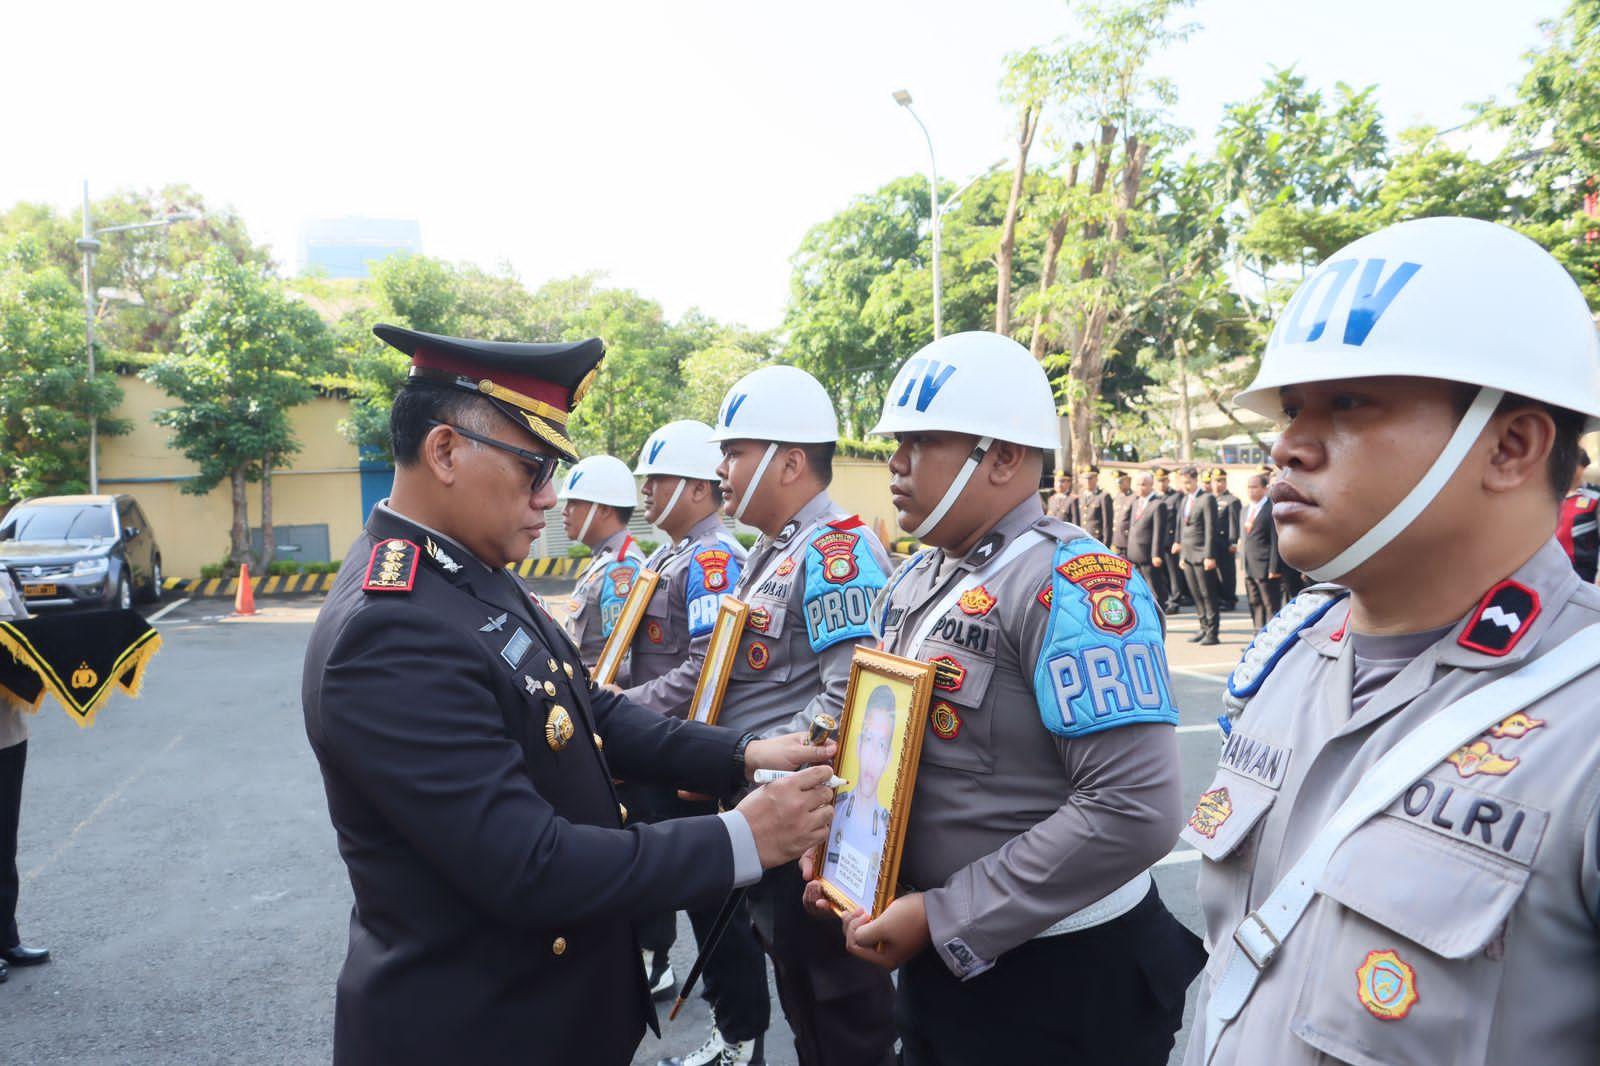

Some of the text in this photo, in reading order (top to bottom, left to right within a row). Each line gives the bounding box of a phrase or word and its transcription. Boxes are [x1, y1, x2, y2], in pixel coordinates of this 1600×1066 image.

[1097, 555, 1128, 569] METRO
[930, 615, 990, 652] POLRI
[1403, 778, 1526, 852] OLRI
